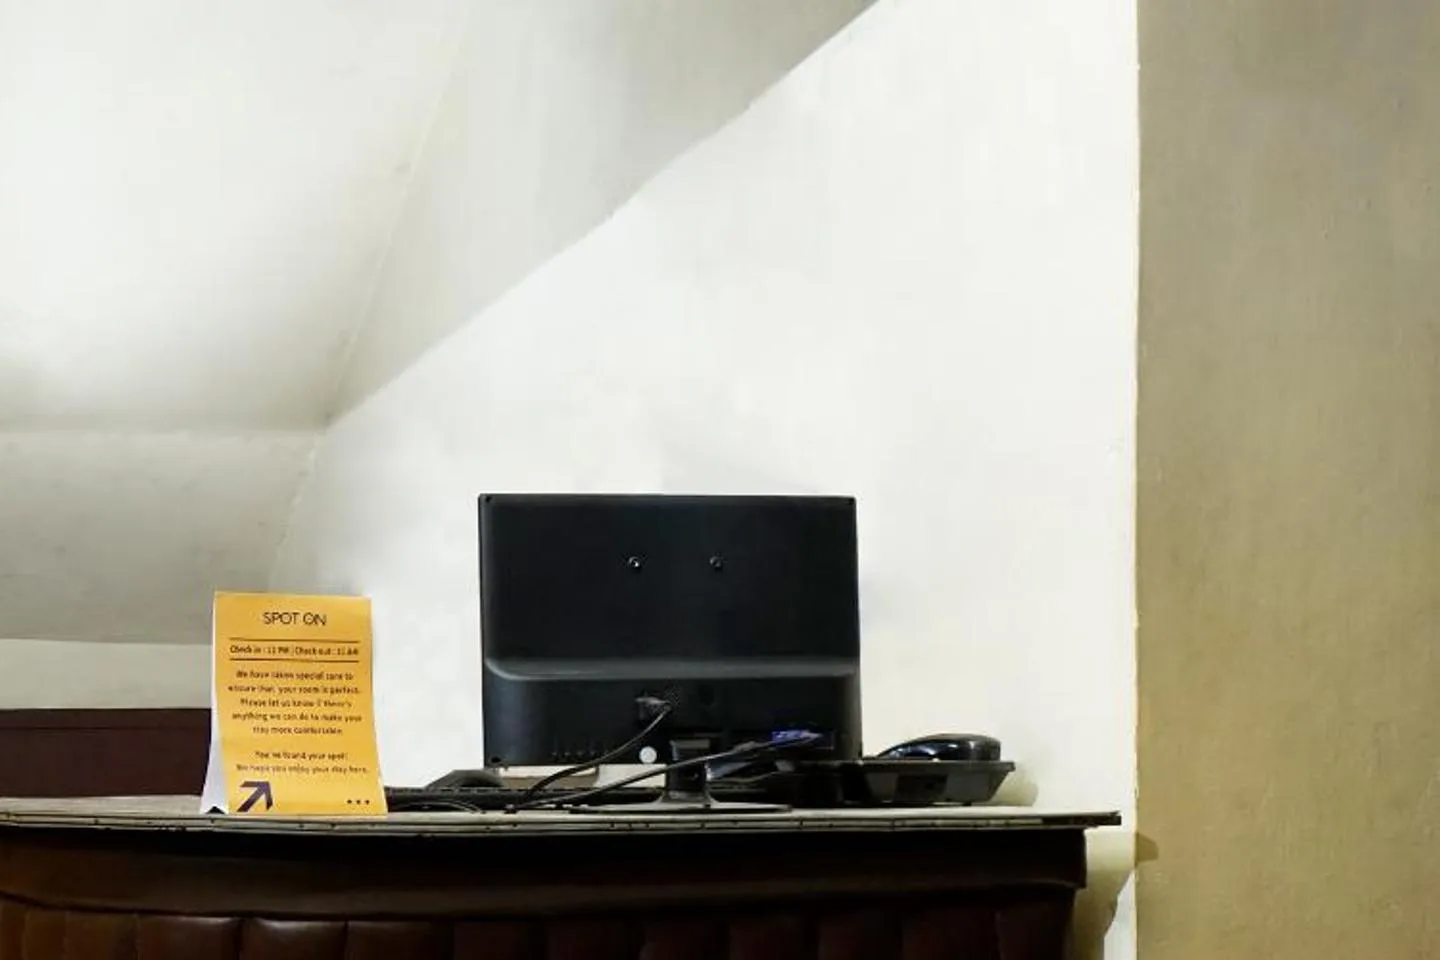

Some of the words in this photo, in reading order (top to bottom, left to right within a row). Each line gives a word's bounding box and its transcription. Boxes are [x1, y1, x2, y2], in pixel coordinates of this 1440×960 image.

[262, 611, 300, 626] SPOT
[302, 611, 327, 626] ON
[229, 644, 252, 654] Check
[295, 645, 317, 656] Check
[295, 670, 324, 682] special
[344, 671, 354, 681] to
[277, 686, 298, 695] your
[298, 686, 320, 694] room
[239, 697, 267, 707] Please
[268, 697, 280, 708] let
[231, 711, 269, 723] anything
[269, 713, 281, 721] we
[299, 711, 309, 721] do
[310, 712, 320, 721] to
[321, 712, 343, 721] make
[344, 715, 362, 724] your
[270, 726, 292, 735] more
